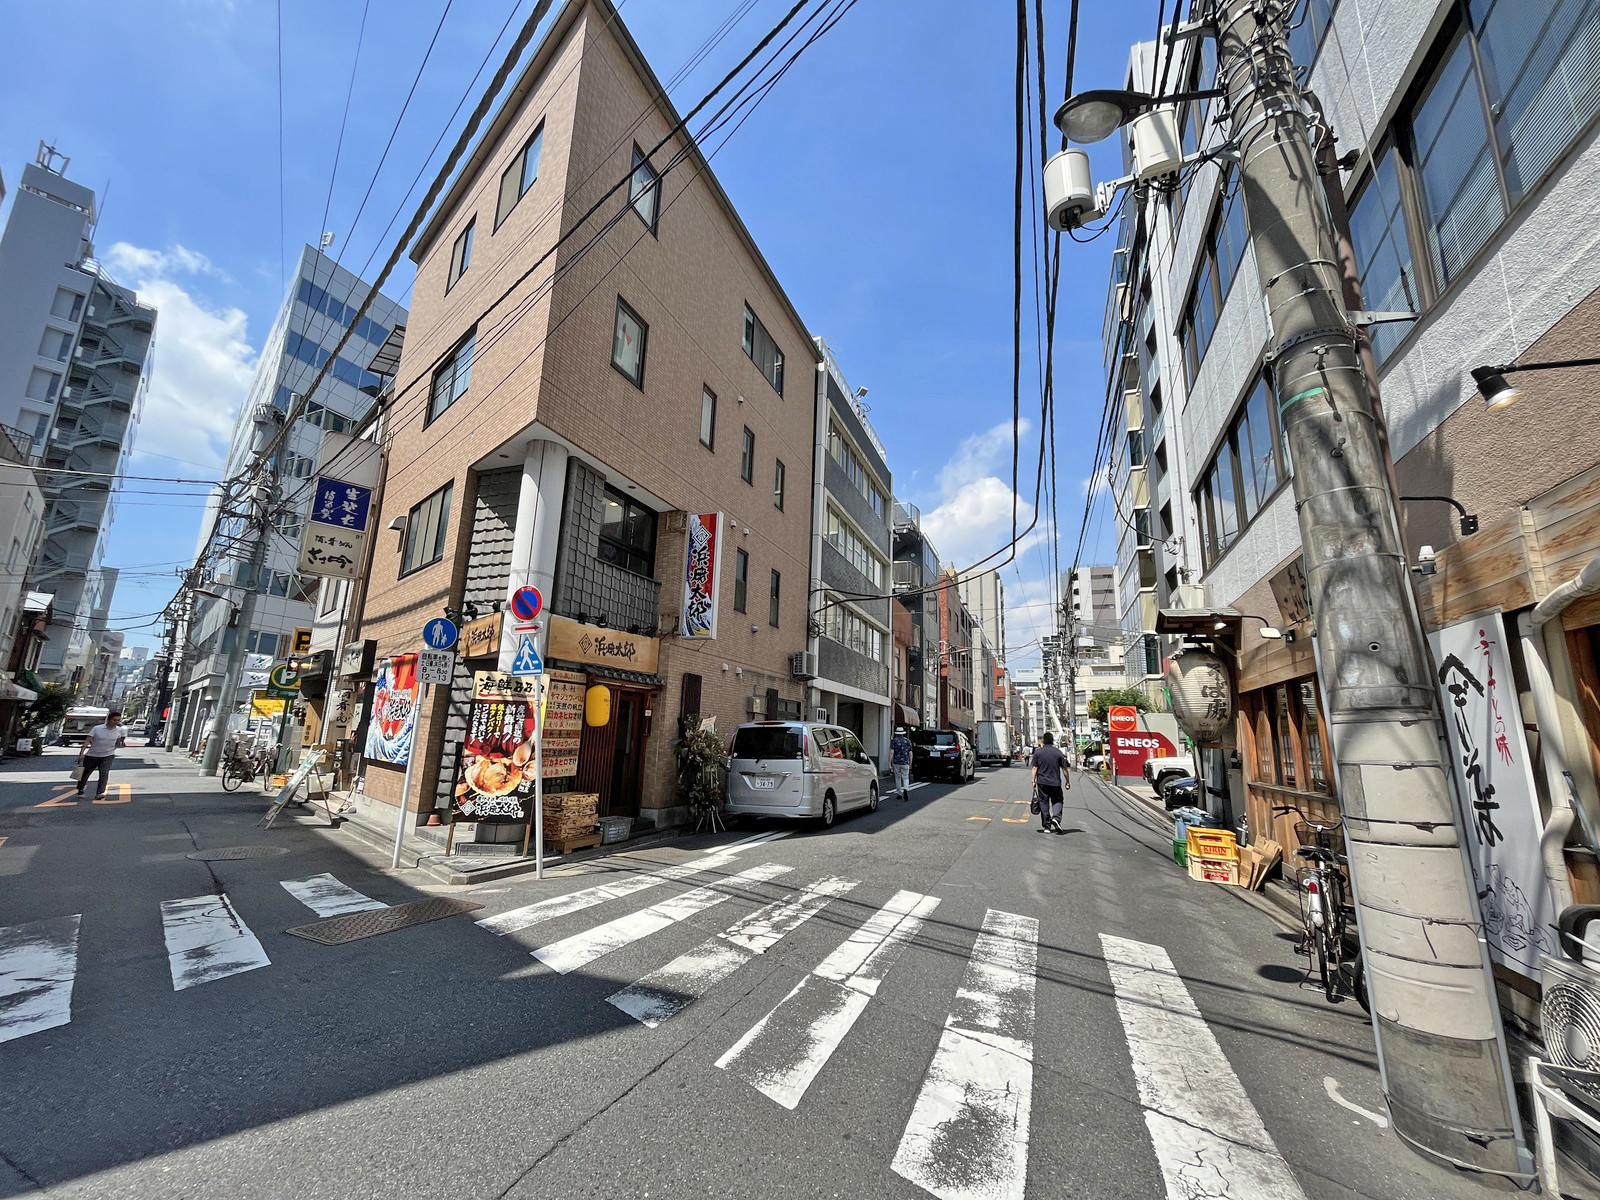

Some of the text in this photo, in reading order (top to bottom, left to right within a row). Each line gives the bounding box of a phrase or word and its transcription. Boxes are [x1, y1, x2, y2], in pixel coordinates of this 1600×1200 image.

[688, 545, 713, 620] 浜焼太郎
[594, 635, 636, 663] 浜焼太郎
[1117, 737, 1160, 749] ENEOS
[1203, 845, 1228, 855] KIRIN
